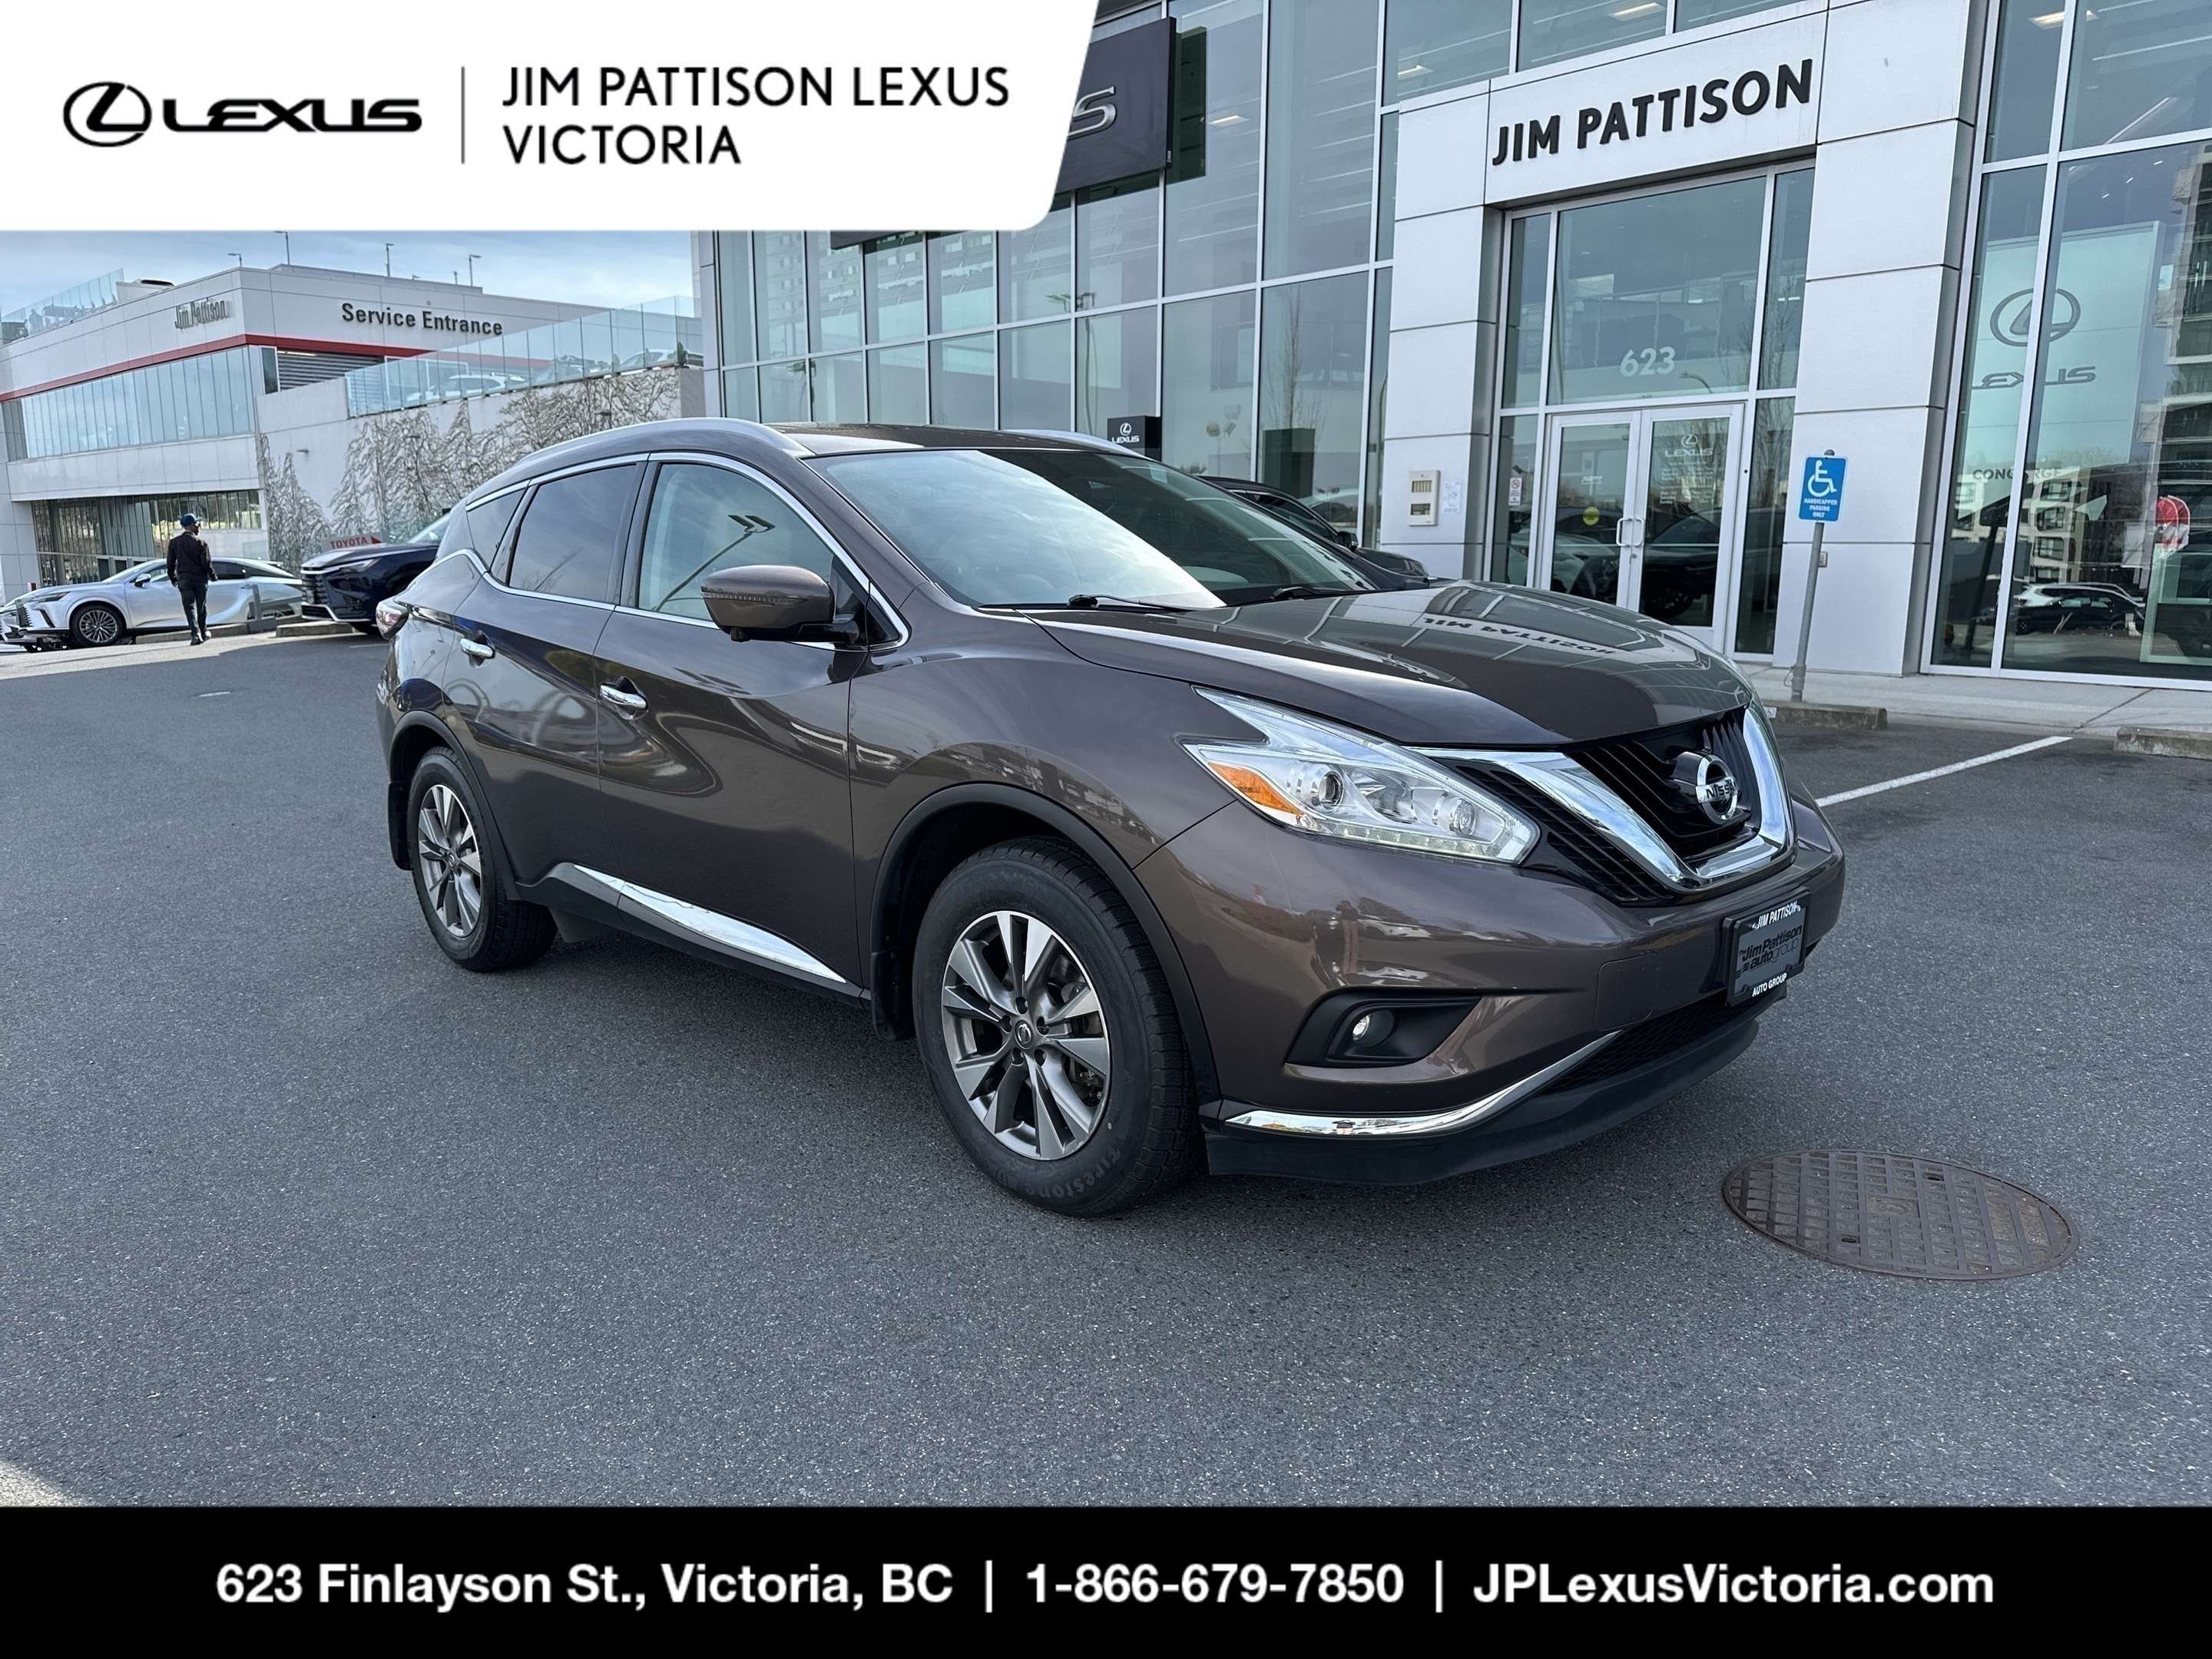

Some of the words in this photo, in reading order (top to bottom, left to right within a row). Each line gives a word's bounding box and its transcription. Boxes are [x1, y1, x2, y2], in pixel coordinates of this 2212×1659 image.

[1492, 114, 1561, 166] JIM
[1578, 58, 1813, 149] PATTISON
[342, 303, 416, 327] Service
[422, 310, 503, 336] Entrance
[1621, 346, 1675, 377] 623
[1665, 448, 1713, 457] LEXUS
[1803, 497, 1838, 505] HANDICAPPED
[330, 537, 368, 549] TOYOTA
[1756, 912, 1770, 929] JIM
[1769, 900, 1798, 924] PATTISON
[1762, 926, 1803, 952] Pattison
[1752, 982, 1768, 997] AUTO
[1768, 972, 1787, 989] GROUP
